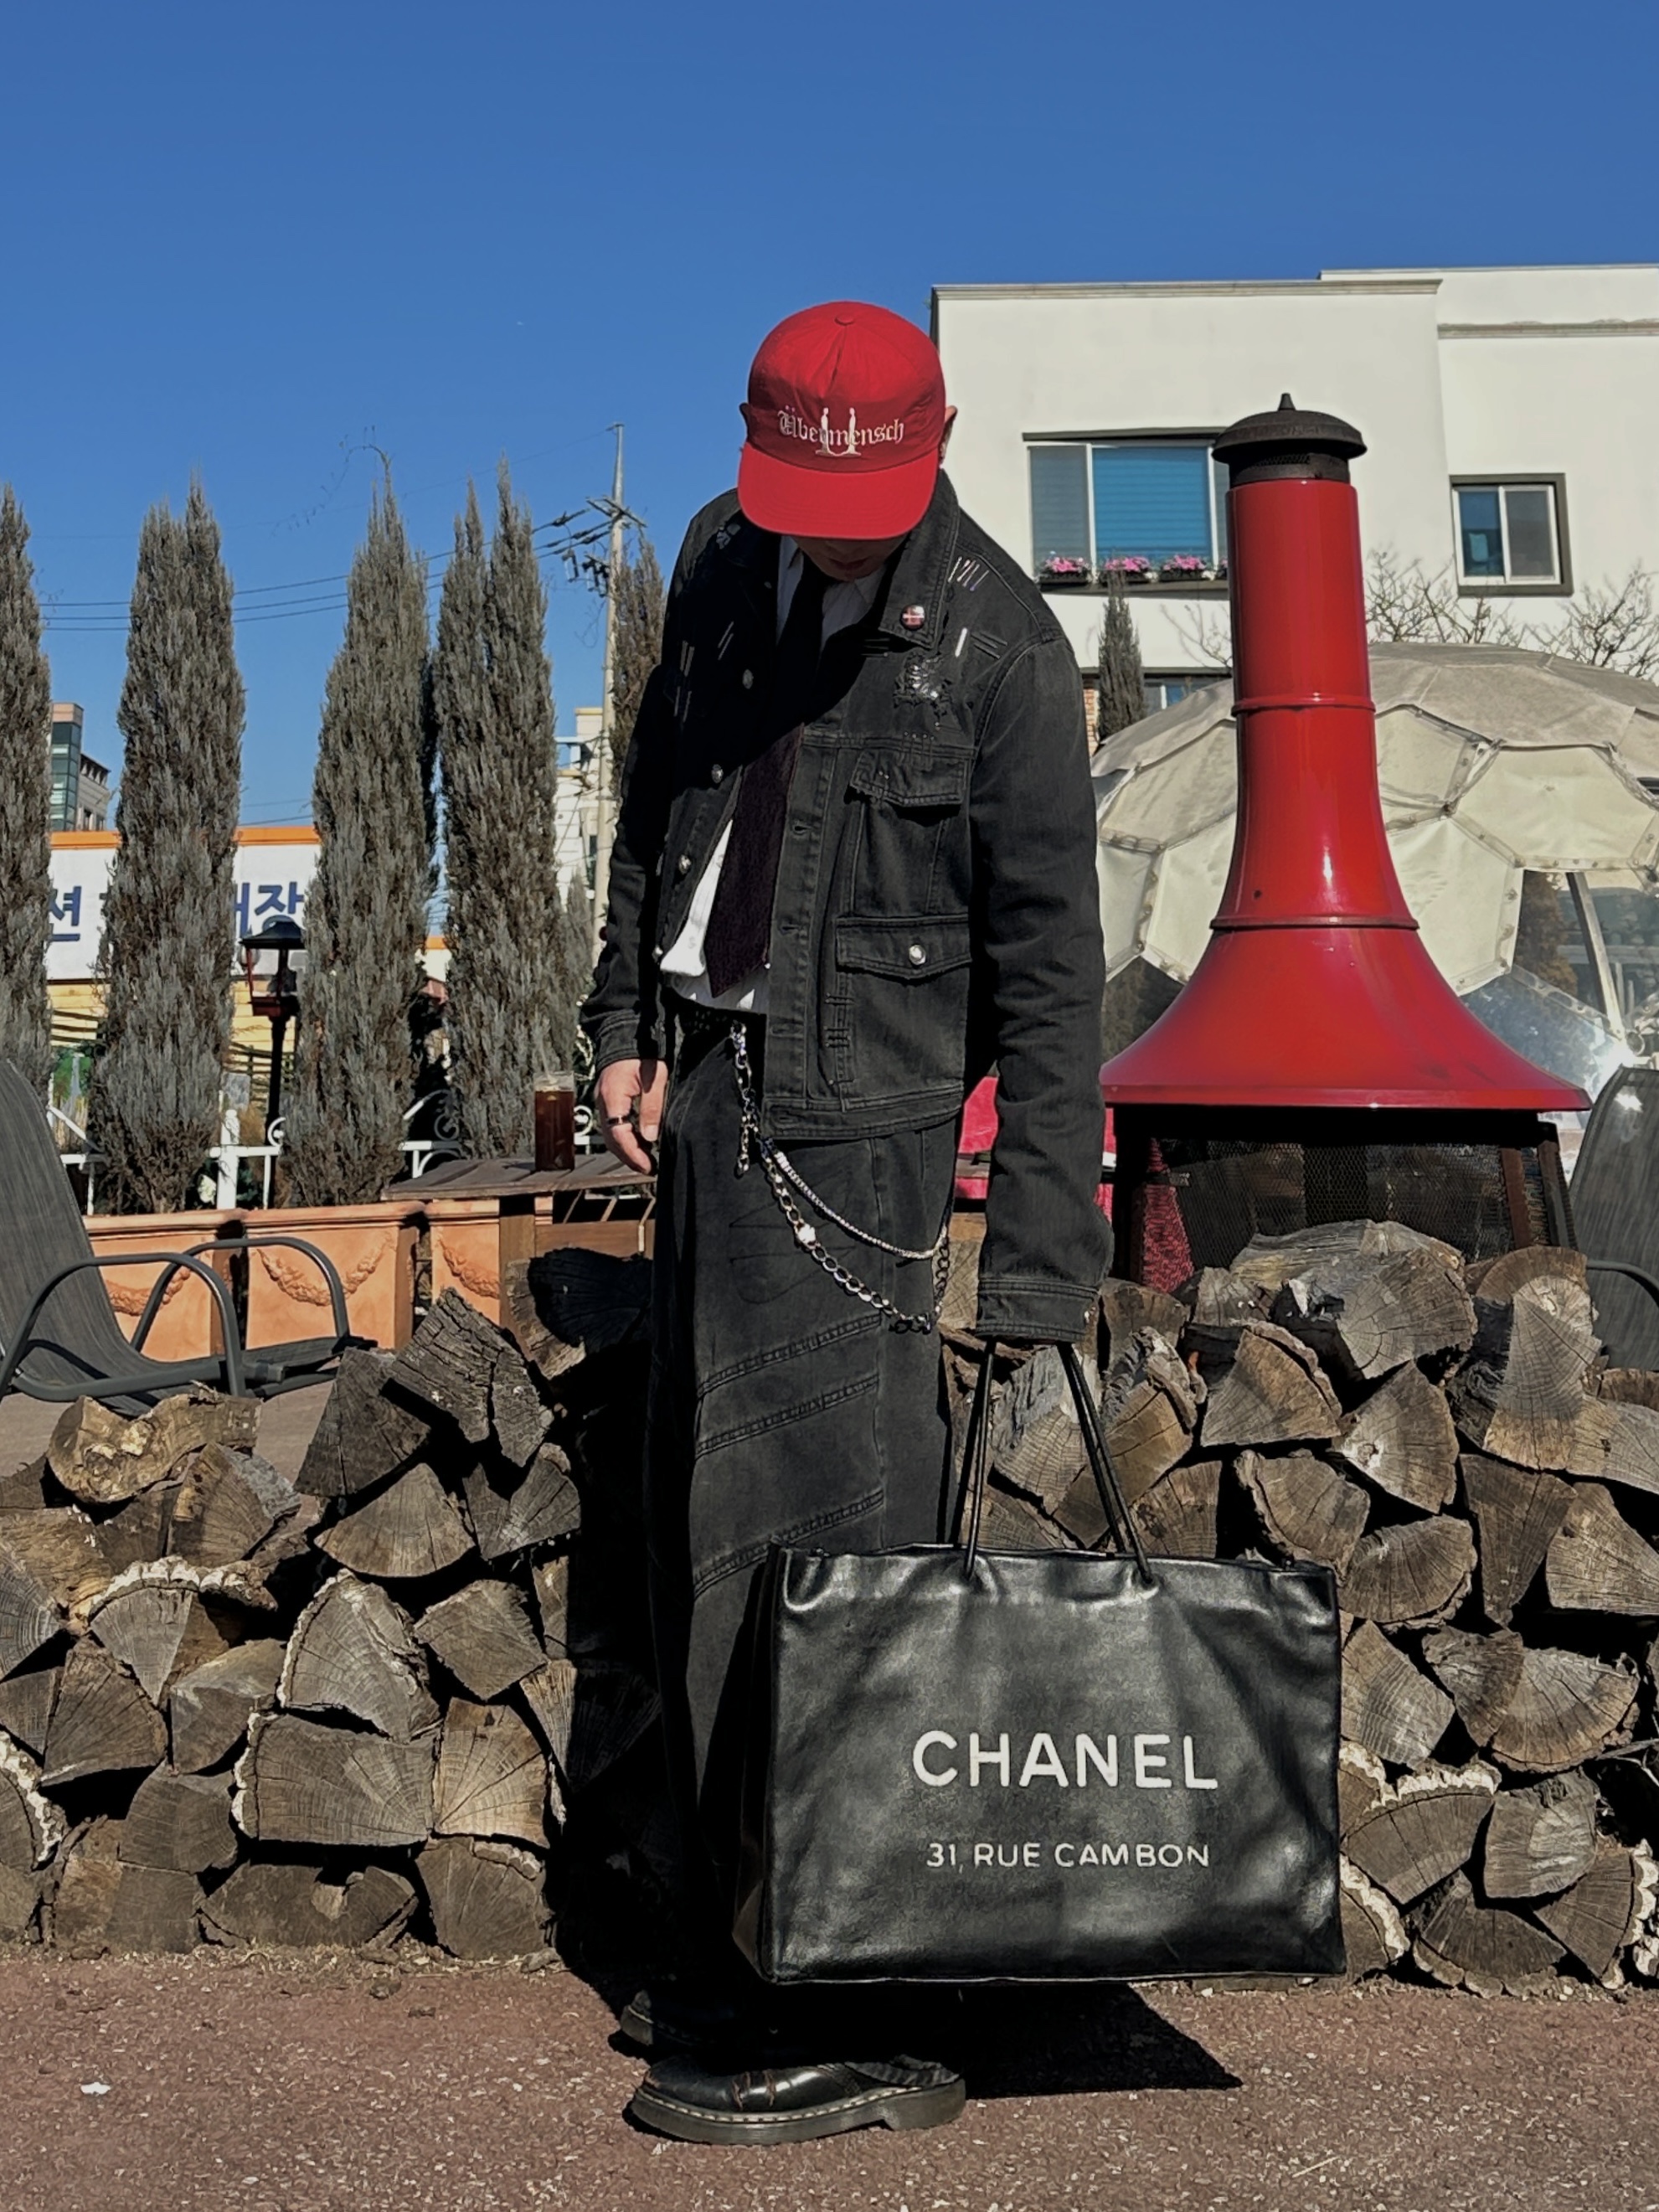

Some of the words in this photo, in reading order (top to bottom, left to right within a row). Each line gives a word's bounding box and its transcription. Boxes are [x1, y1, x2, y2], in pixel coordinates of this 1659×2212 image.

[913, 1730, 1218, 1790] CHANEL
[973, 1843, 1041, 1868] RUE
[1054, 1843, 1210, 1868] CAMBON
